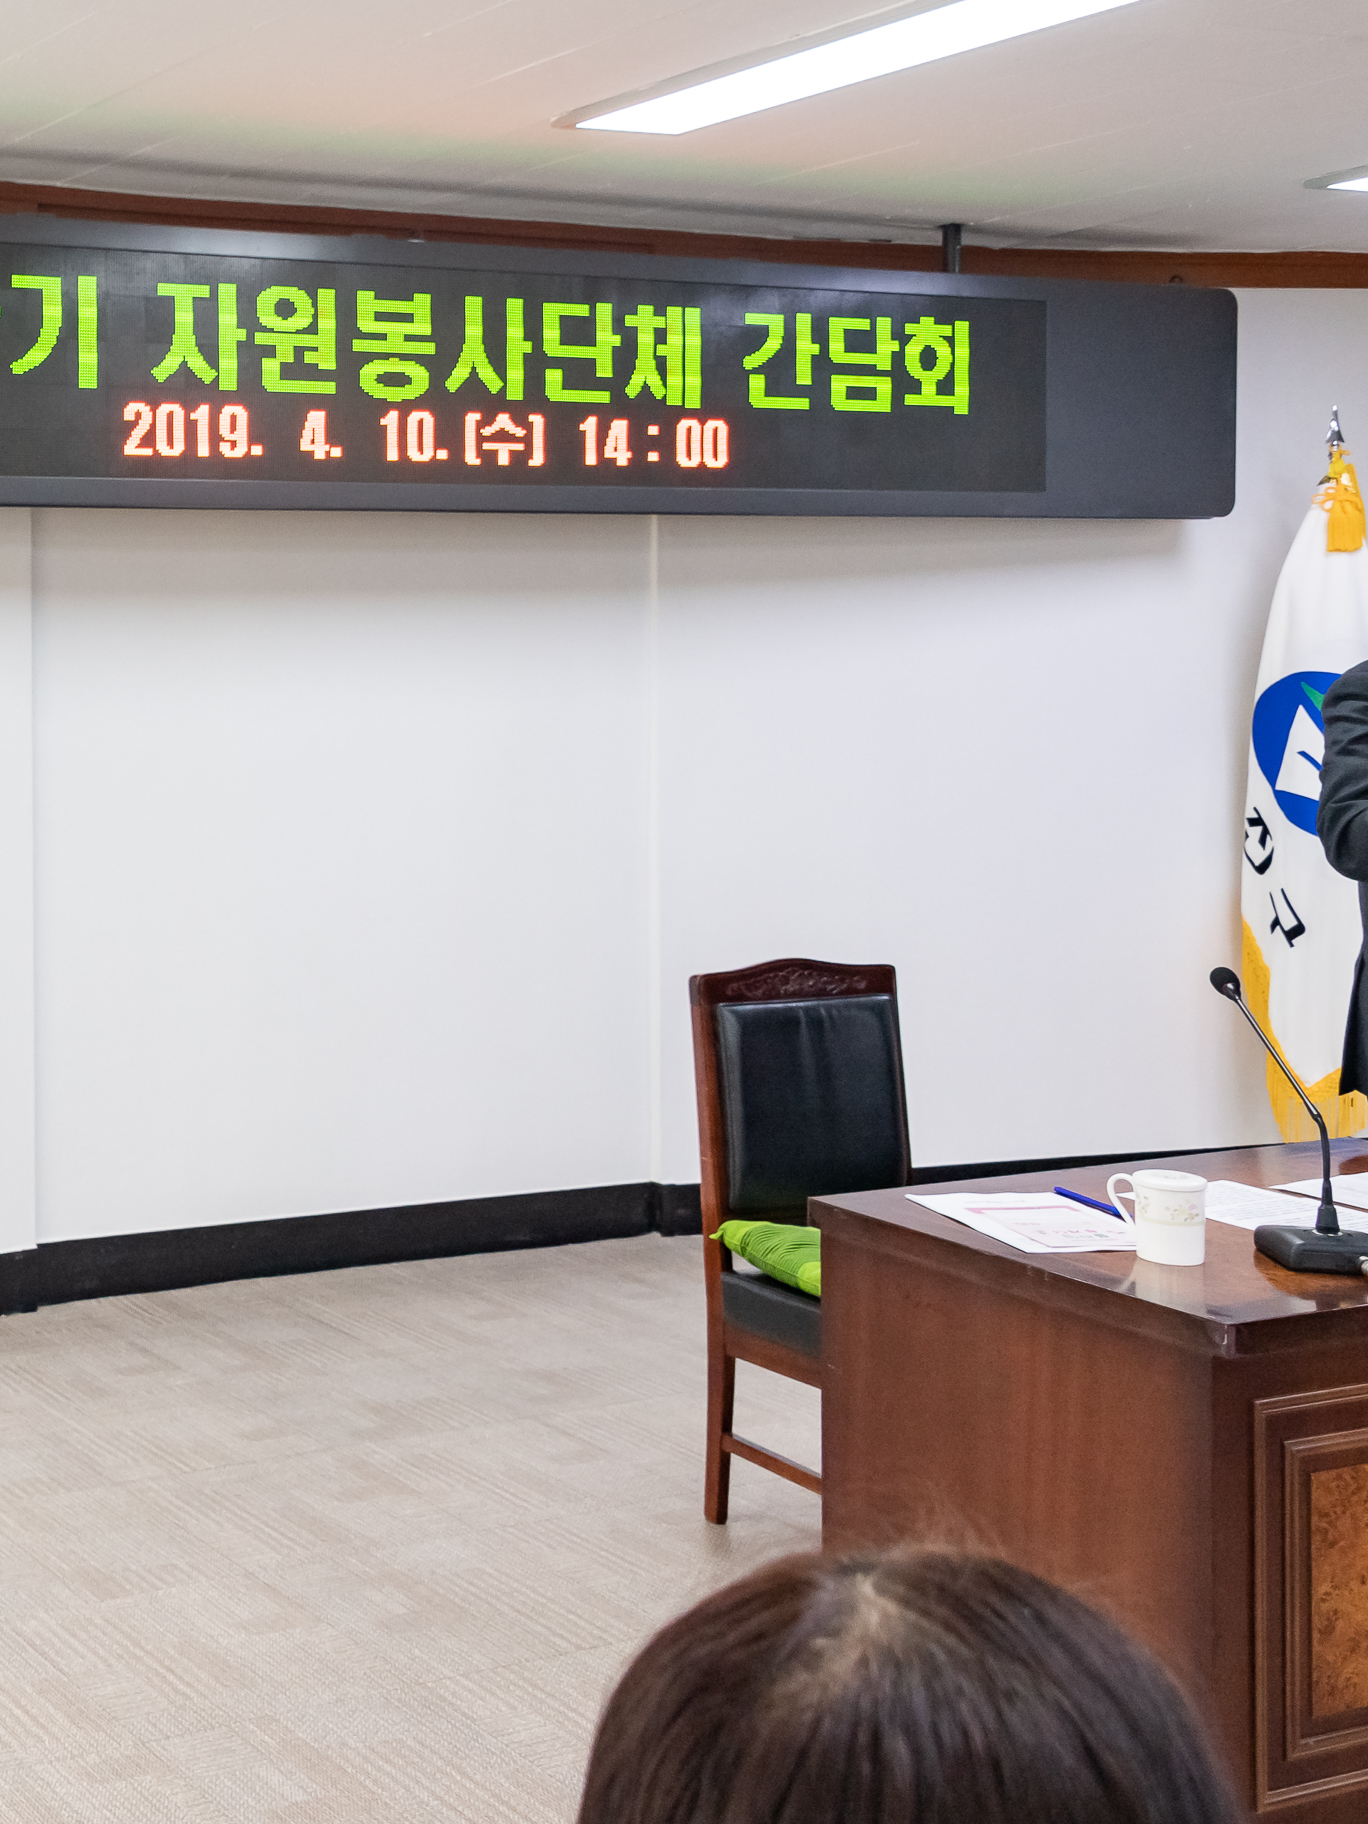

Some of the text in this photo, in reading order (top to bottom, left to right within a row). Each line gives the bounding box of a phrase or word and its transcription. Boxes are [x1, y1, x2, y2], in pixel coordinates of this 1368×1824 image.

[150, 282, 702, 409] 자원봉사단체
[742, 312, 971, 415] 간담회
[123, 400, 264, 459] 2019.
[299, 409, 344, 461] 4.
